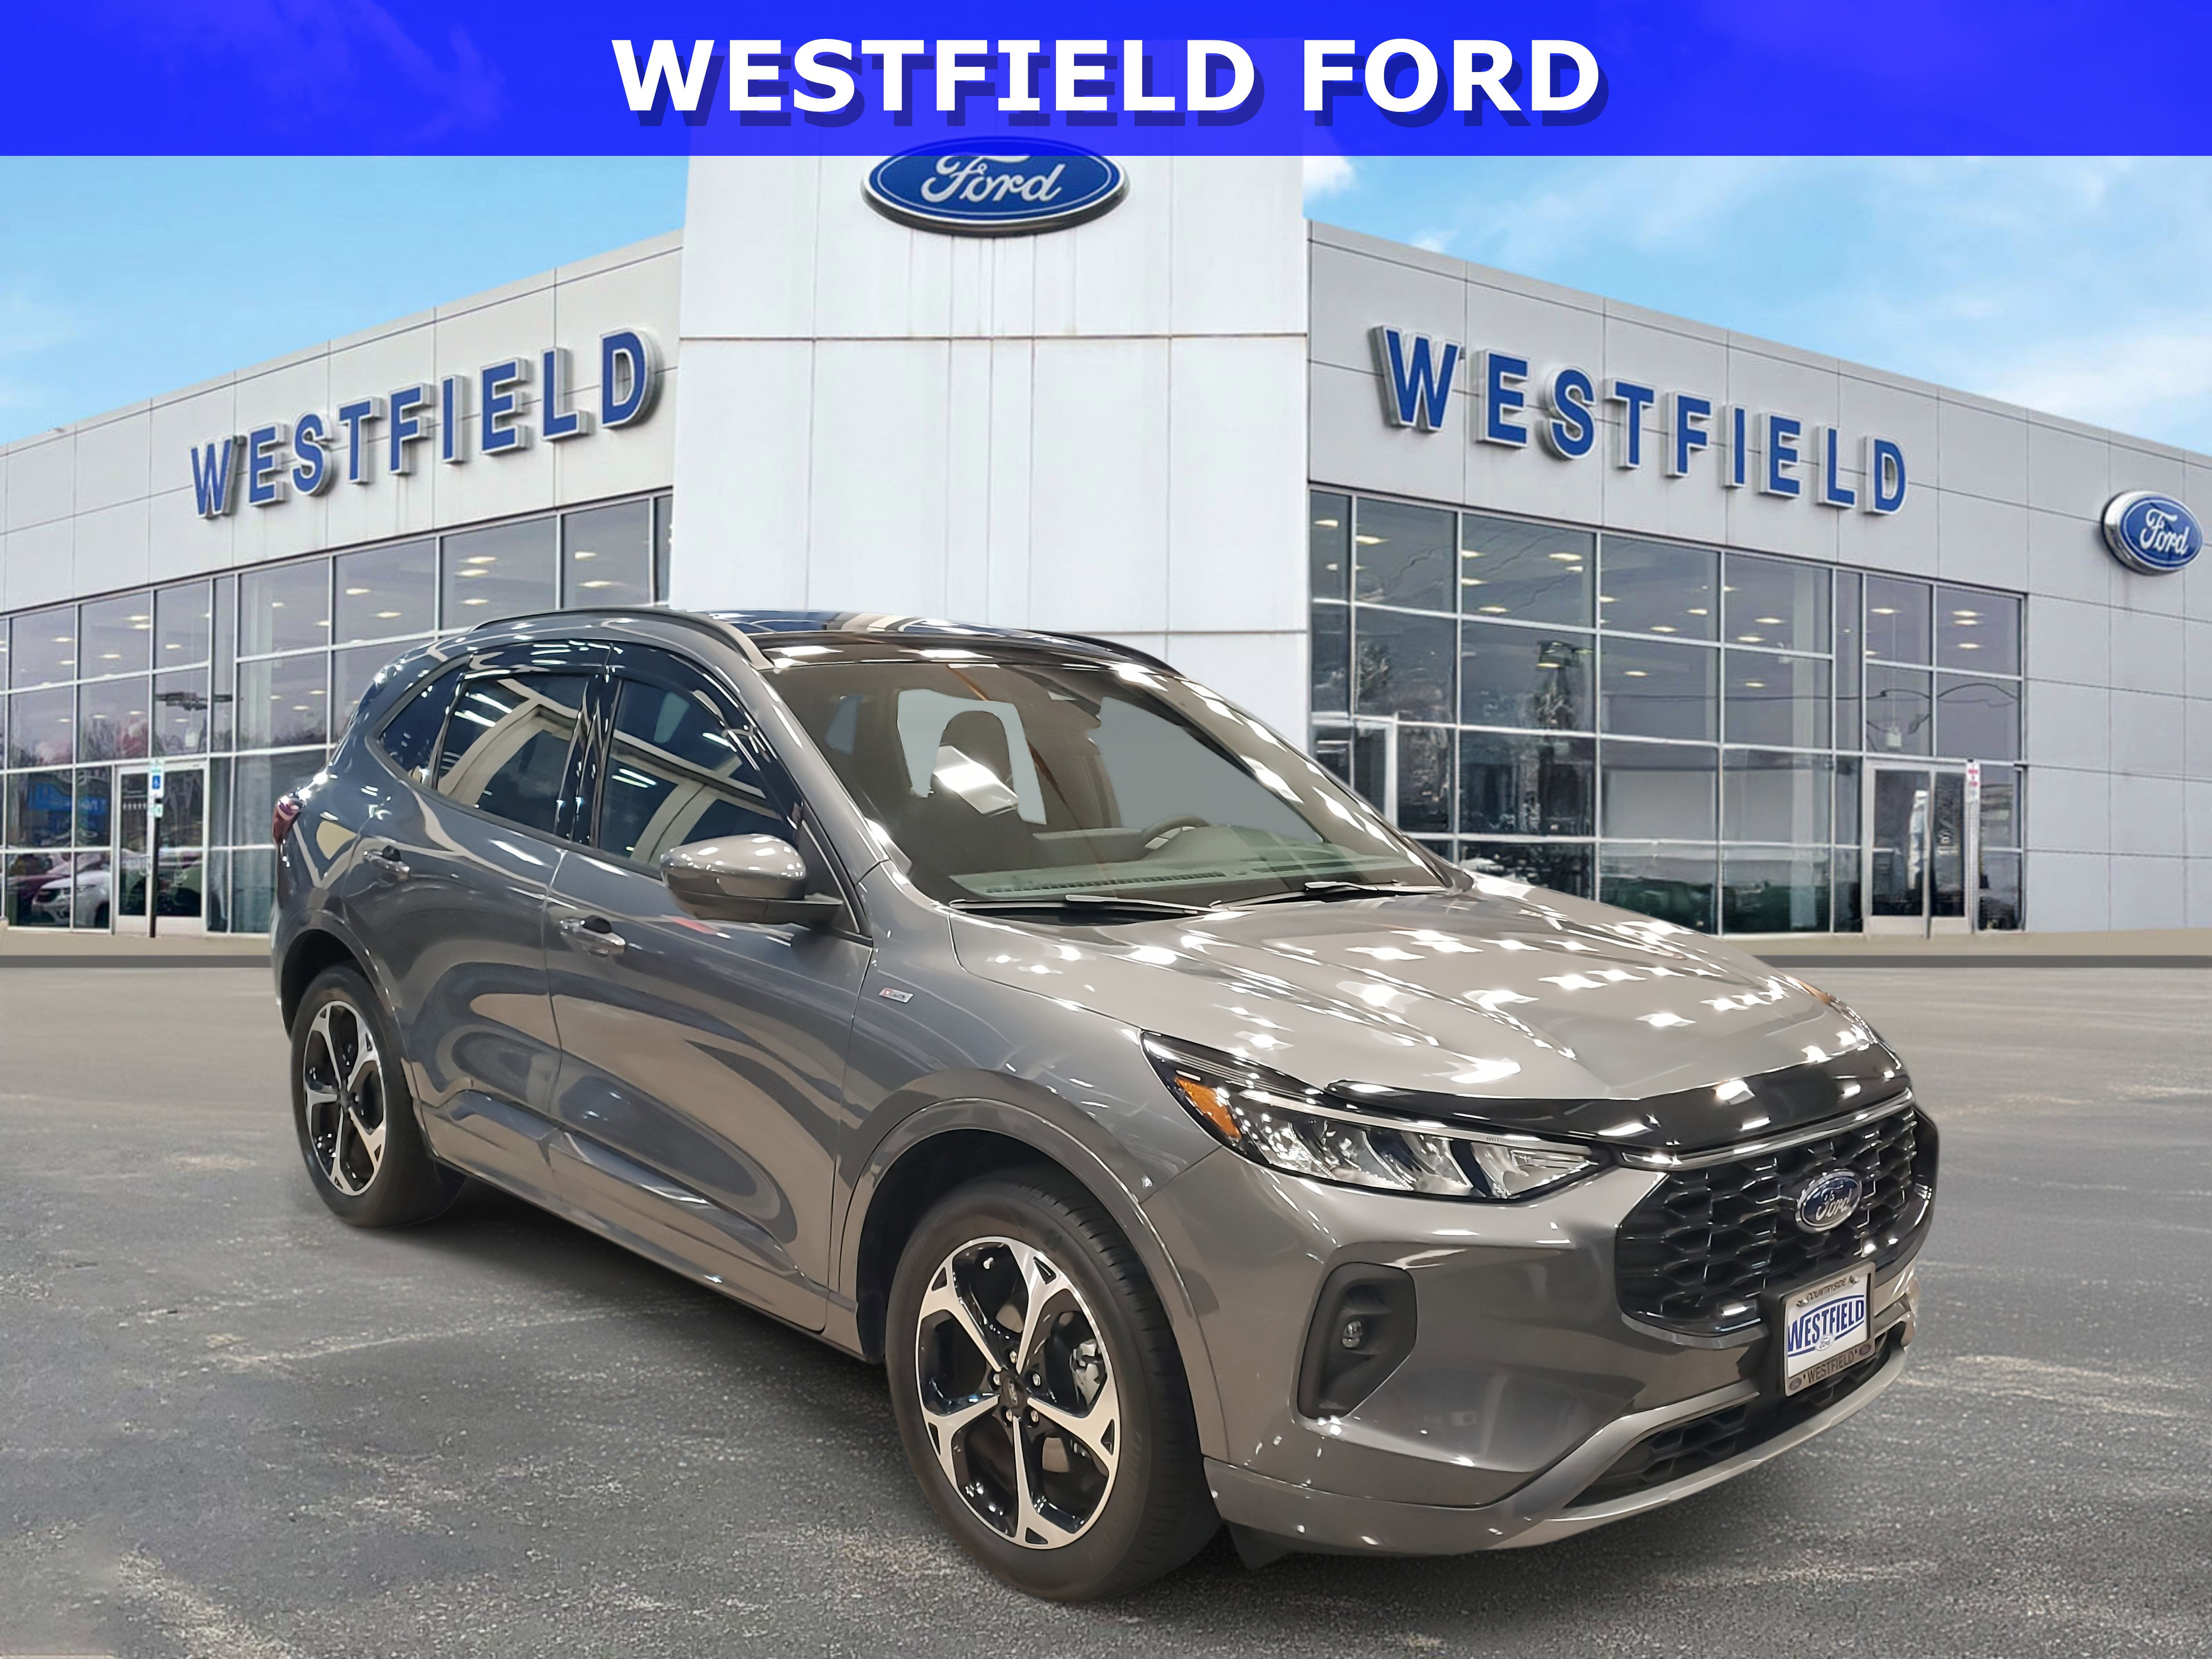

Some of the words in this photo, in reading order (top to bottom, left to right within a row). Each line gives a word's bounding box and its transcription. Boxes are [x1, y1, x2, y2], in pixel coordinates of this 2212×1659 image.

[921, 153, 1065, 202] Ford
[190, 329, 655, 517] WESTFIELD
[1375, 326, 1908, 515] WESTFIELD
[2140, 508, 2190, 555] Ford
[1816, 1185, 1852, 1220] Ford
[1788, 1300, 1864, 1352] WESTFIELD
[1807, 1351, 1854, 1384] WESTFIELD
